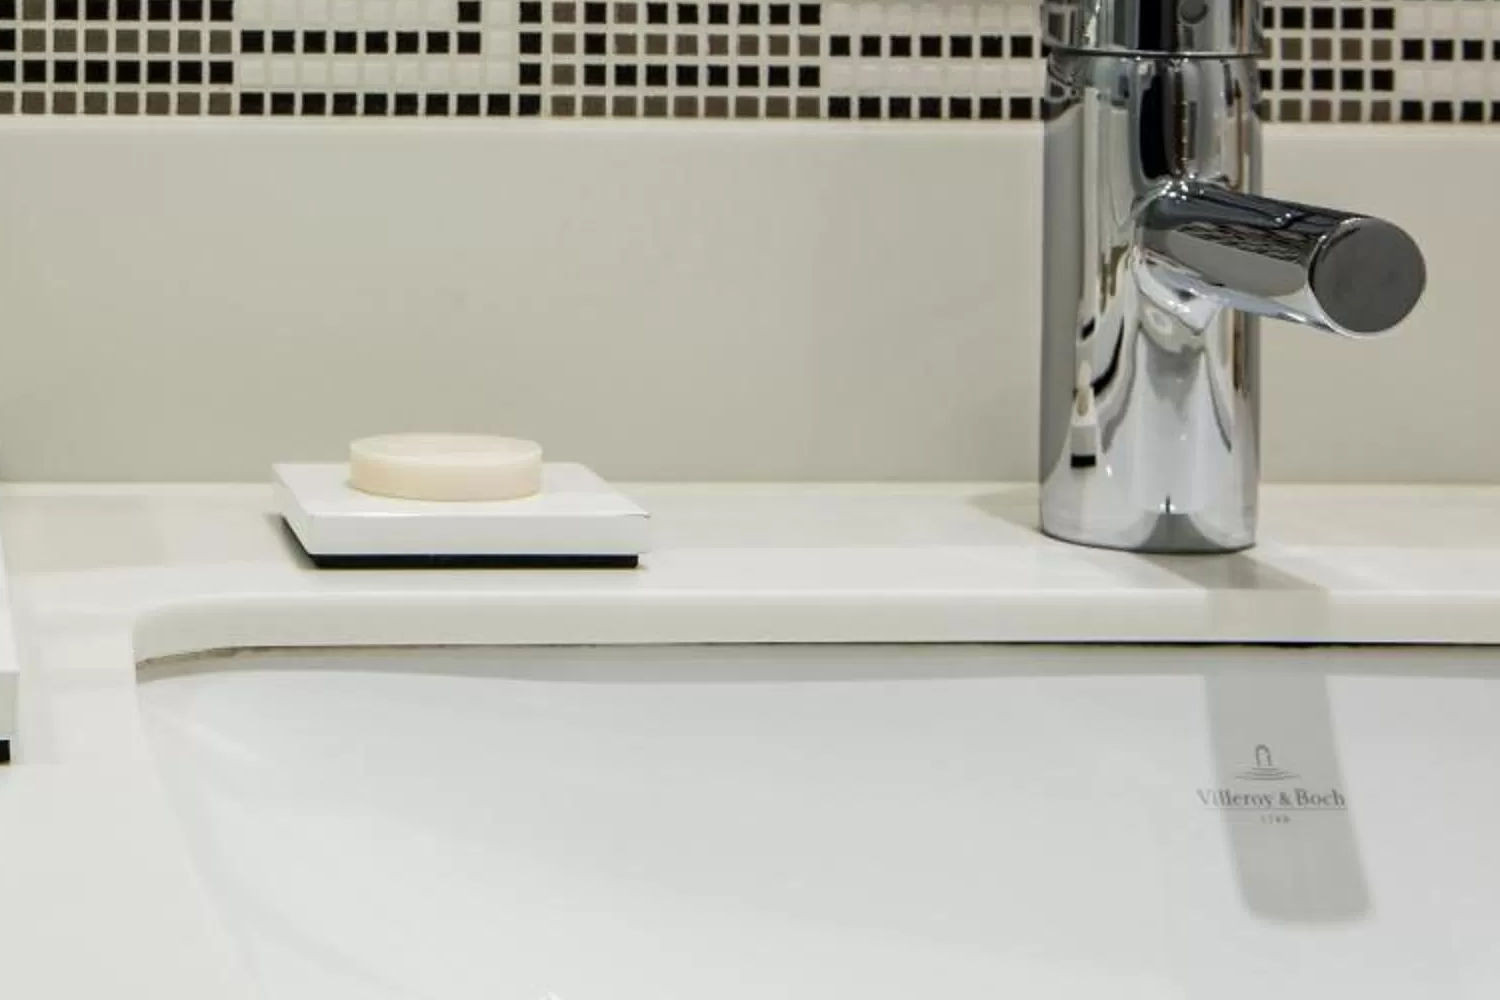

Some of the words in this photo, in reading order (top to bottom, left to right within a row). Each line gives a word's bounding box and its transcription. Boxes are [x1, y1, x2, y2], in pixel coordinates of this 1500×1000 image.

[1196, 788, 1273, 809] Villeroy
[1279, 792, 1290, 807] &
[1294, 788, 1346, 806] Boch
